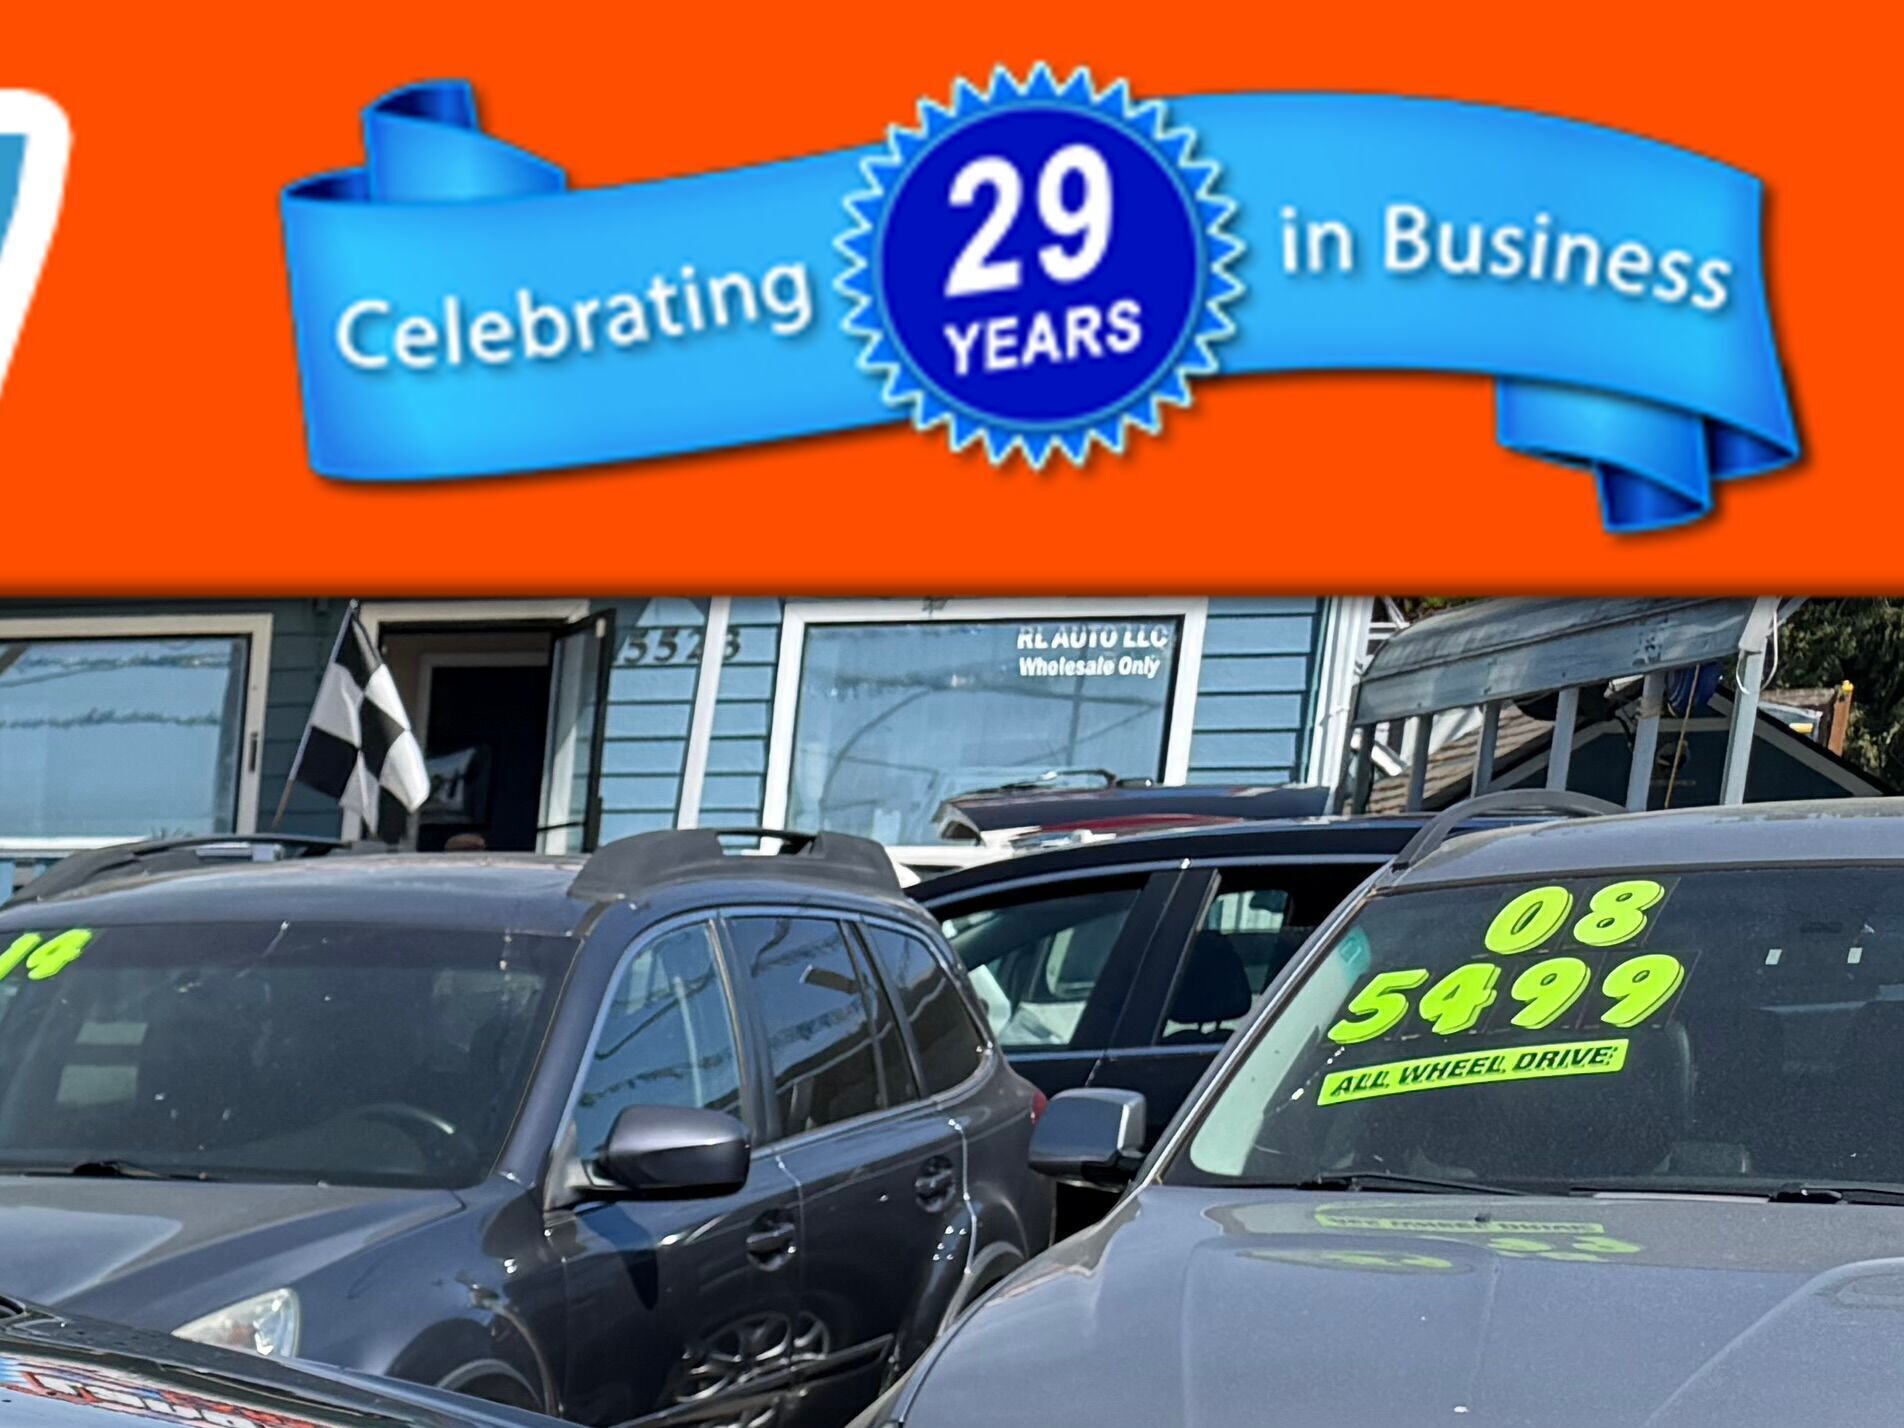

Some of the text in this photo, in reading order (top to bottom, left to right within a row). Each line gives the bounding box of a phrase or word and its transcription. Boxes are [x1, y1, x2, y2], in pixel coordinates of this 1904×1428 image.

[1051, 624, 1118, 649] AUTO
[1122, 624, 1169, 649] LLC
[1019, 655, 1161, 679] Wholesale Only
[1484, 880, 1666, 956] 08
[1327, 953, 1685, 1045] 5499
[1331, 1045, 1618, 1096] ALL WHEEL DRIVE
